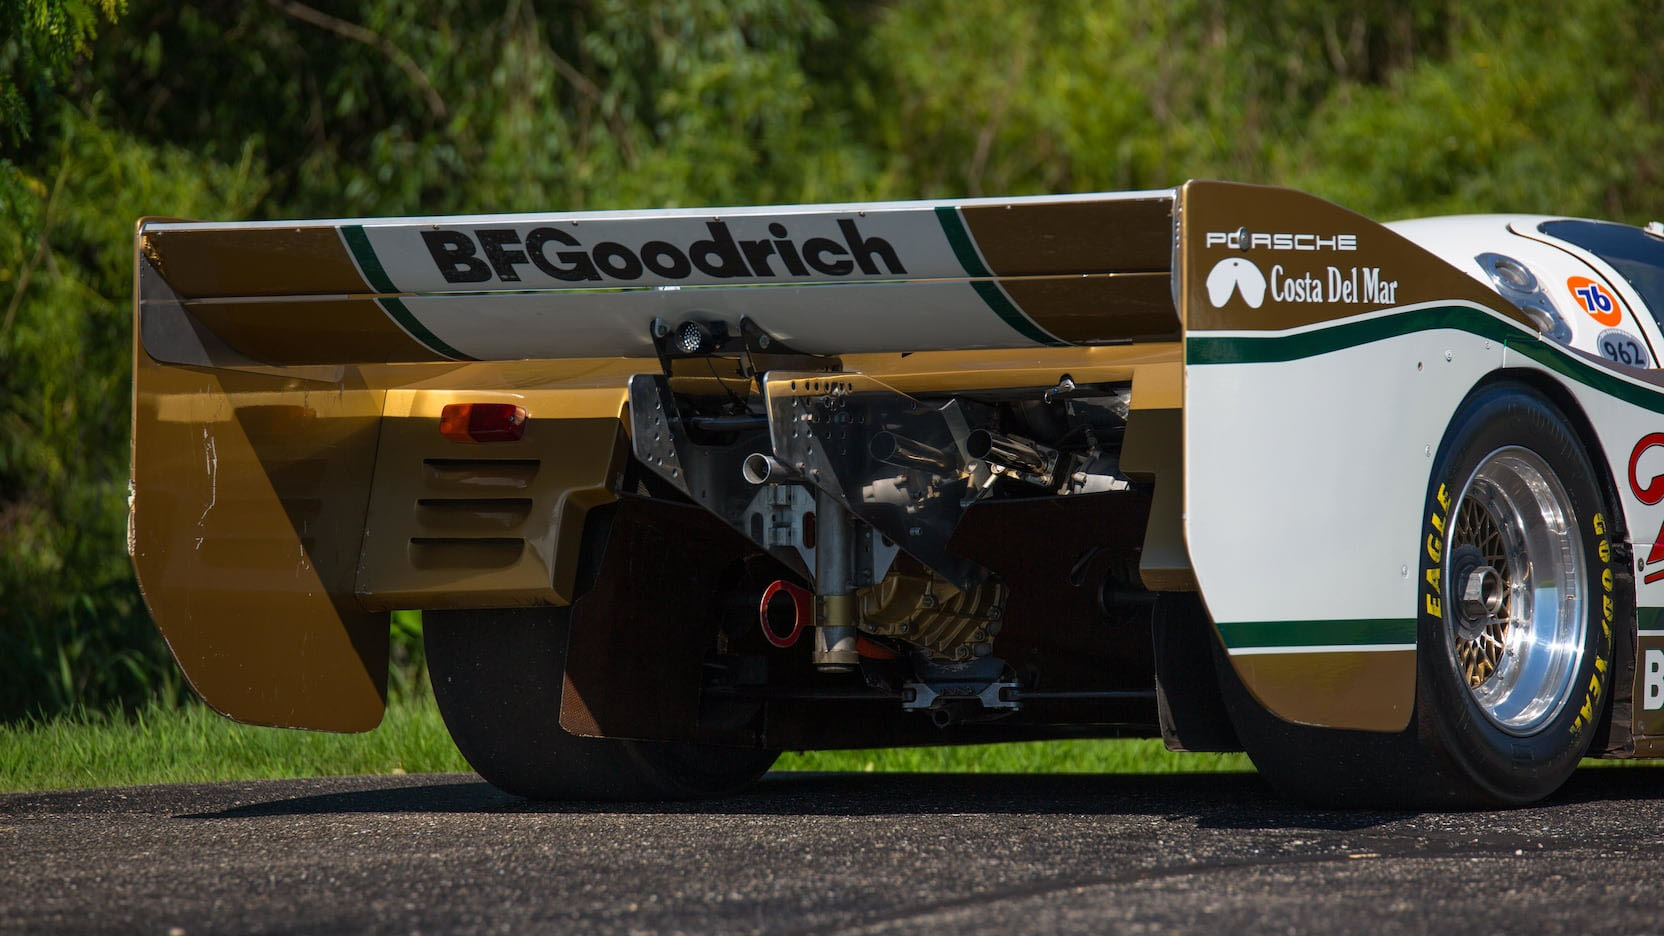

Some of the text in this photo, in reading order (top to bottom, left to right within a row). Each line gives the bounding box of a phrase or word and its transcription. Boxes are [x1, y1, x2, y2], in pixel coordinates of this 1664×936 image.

[420, 218, 907, 284] BFGoodrich
[1271, 264, 1398, 304] Costa Del Mar
[1575, 284, 1613, 314] 76
[1604, 341, 1645, 365] 962
[1426, 482, 1451, 618] EAGLE
